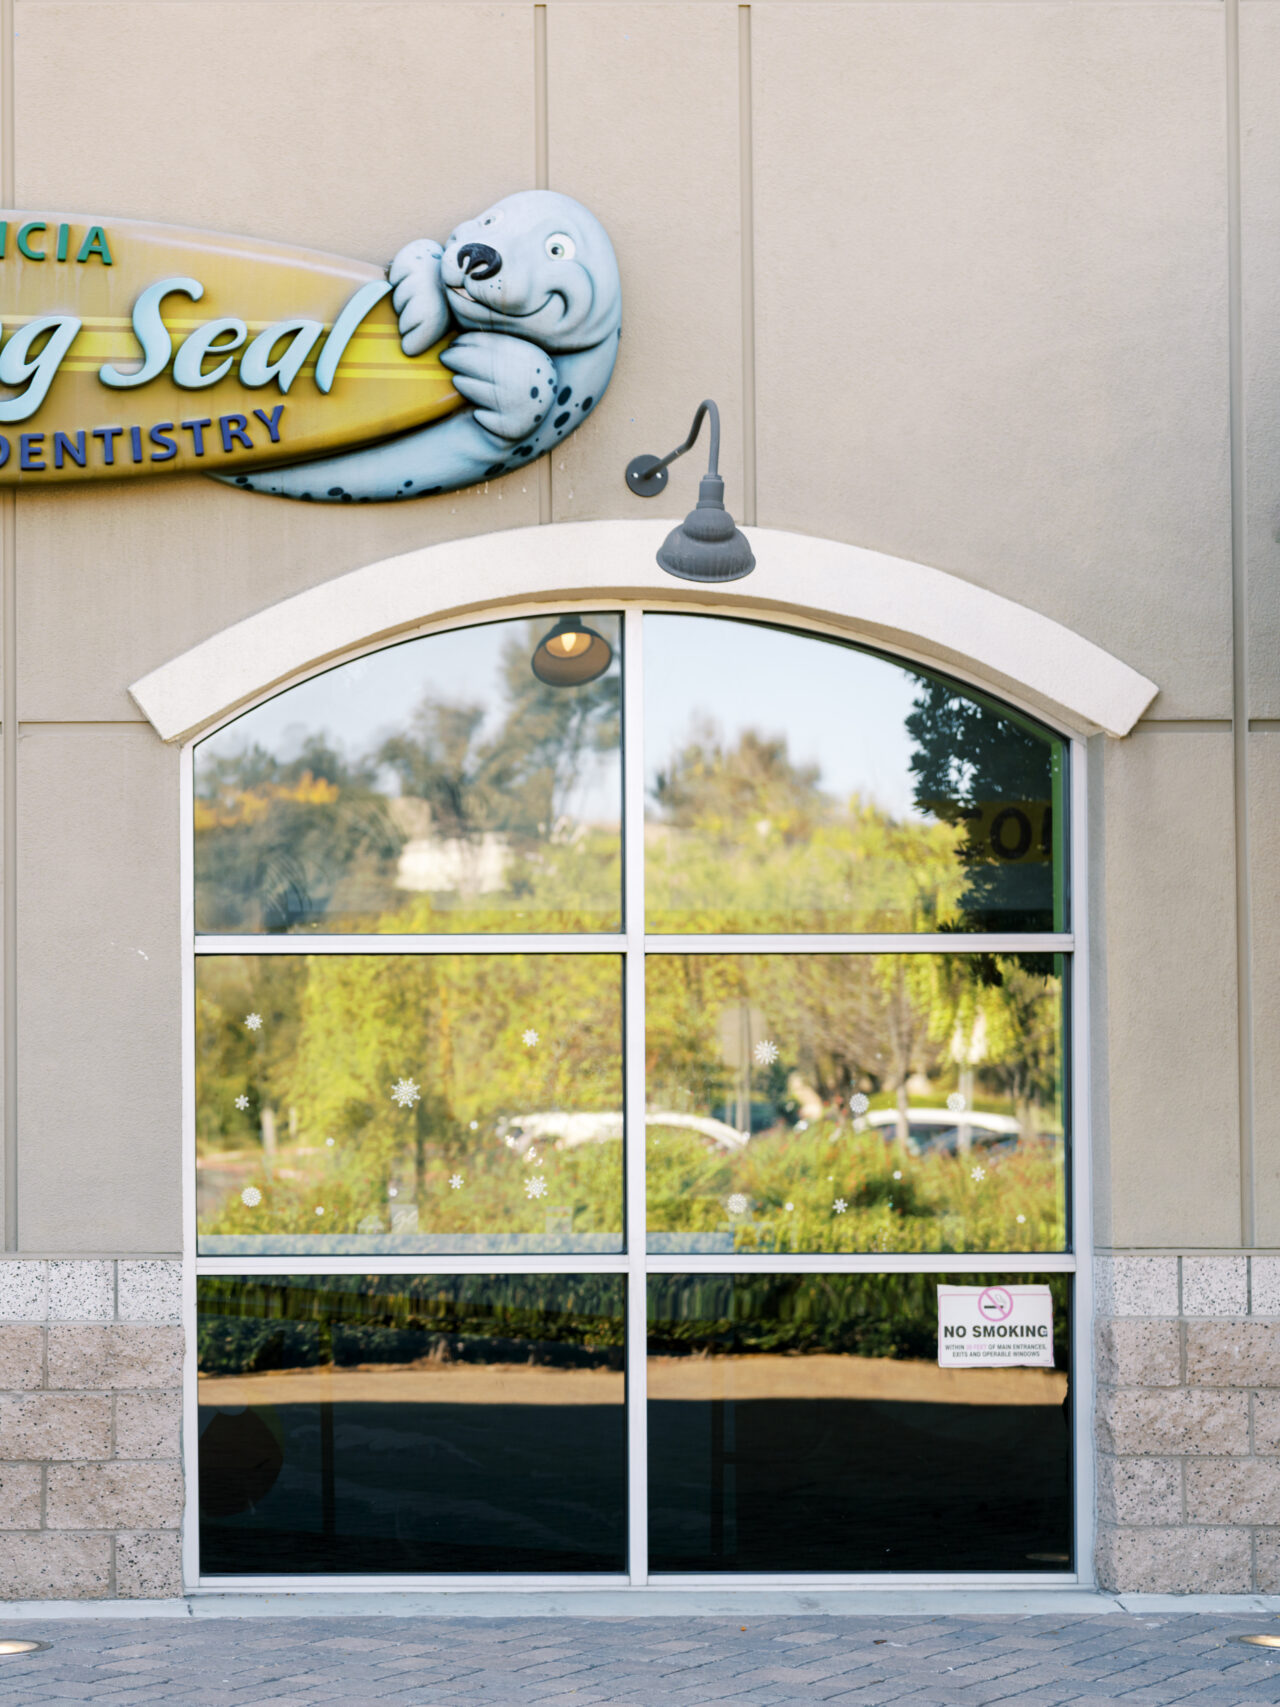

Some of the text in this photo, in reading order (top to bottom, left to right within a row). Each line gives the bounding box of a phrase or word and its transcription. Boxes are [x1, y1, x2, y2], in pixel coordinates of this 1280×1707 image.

[99, 276, 394, 396] Seal
[944, 1326, 1048, 1337] NO SMOKING
